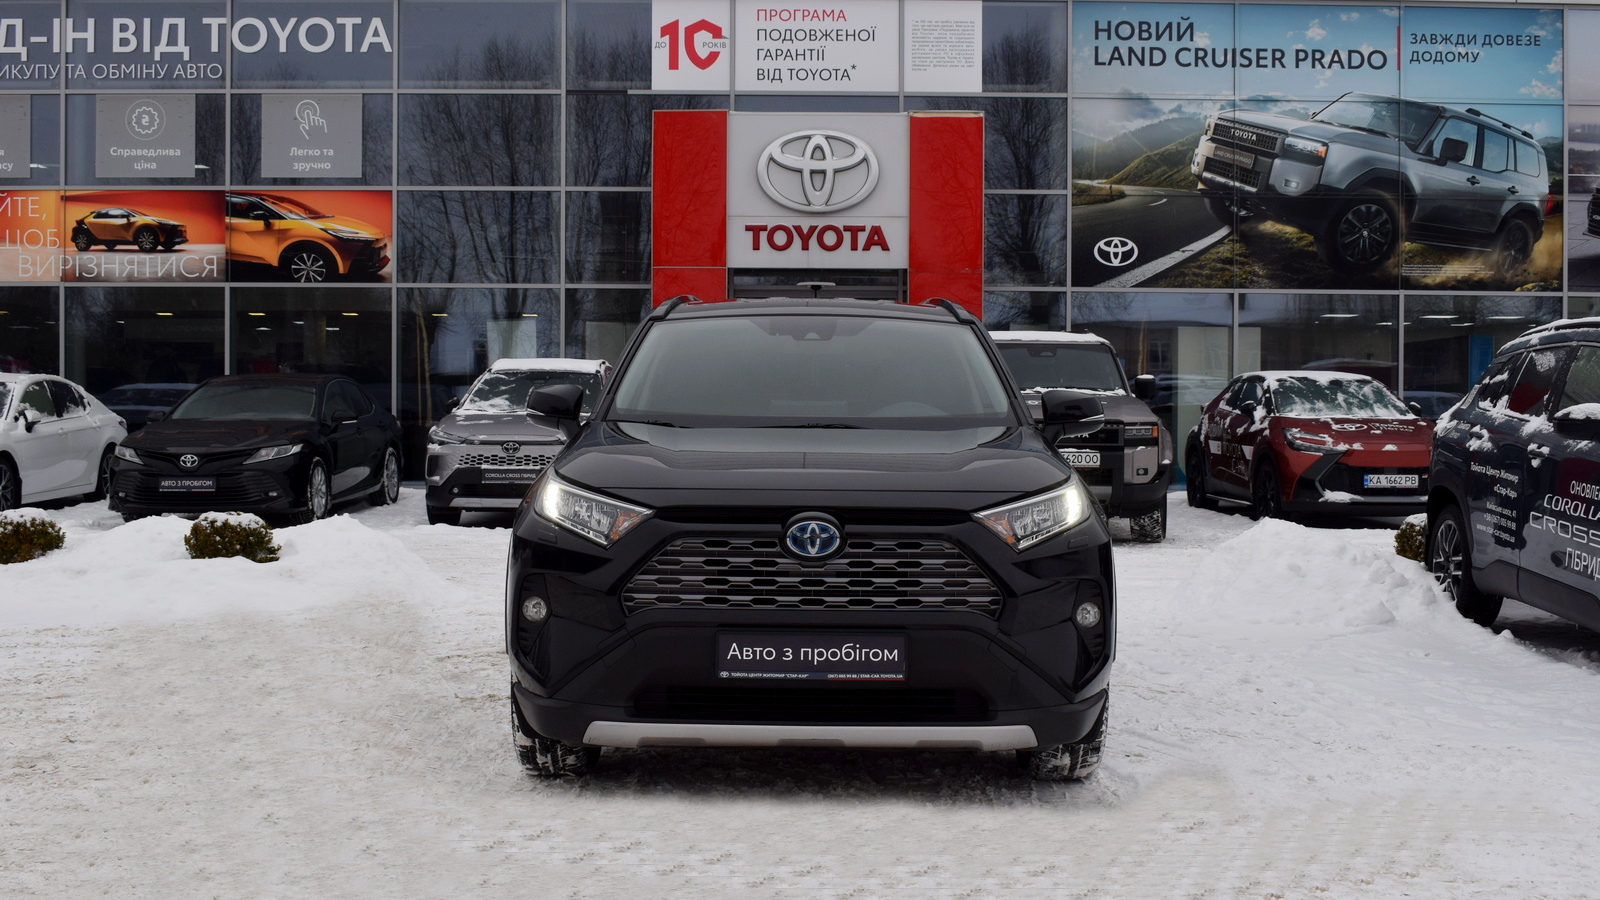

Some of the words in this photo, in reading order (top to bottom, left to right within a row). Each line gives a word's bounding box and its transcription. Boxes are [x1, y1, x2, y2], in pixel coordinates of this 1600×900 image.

[756, 8, 847, 22] ПРОГРАМА
[756, 26, 876, 44] ПОДОВЖЕНОЇ
[1094, 16, 1194, 42] НОВИЙ
[112, 18, 190, 62] ВІД
[202, 17, 392, 52] TOYOTA
[654, 42, 666, 50] ДО
[1410, 32, 1478, 46] ЗАВЖДИ
[1482, 34, 1542, 48] ДОВЕЗЕ
[756, 46, 826, 61] ГАРАНТІЇ
[1094, 45, 1166, 67] LAND
[1174, 47, 1288, 69] CRUISER
[1295, 49, 1388, 70] PRADO
[1410, 50, 1480, 66] ДОДОМУ
[66, 64, 86, 79] ТА
[92, 64, 168, 79] ОБМІНУ
[173, 64, 222, 79] АВТО
[756, 68, 782, 83] ВІД
[1230, 128, 1257, 140] TOYOTA
[110, 147, 180, 158] Справедлива
[290, 147, 318, 157] Легко
[134, 160, 156, 171] ціна
[292, 162, 331, 172] зручно
[745, 224, 890, 251] TOYOTA
[18, 254, 218, 278] ВИРІЗНЯТИСЯ
[1062, 454, 1082, 464] 620
[1384, 476, 1403, 484] 1662
[1470, 462, 1486, 474] Тойота
[1486, 466, 1500, 478] Центр
[1500, 469, 1518, 484] Житомир
[727, 642, 776, 660] Авто
[782, 648, 793, 660] з
[800, 644, 898, 665] пробігом
